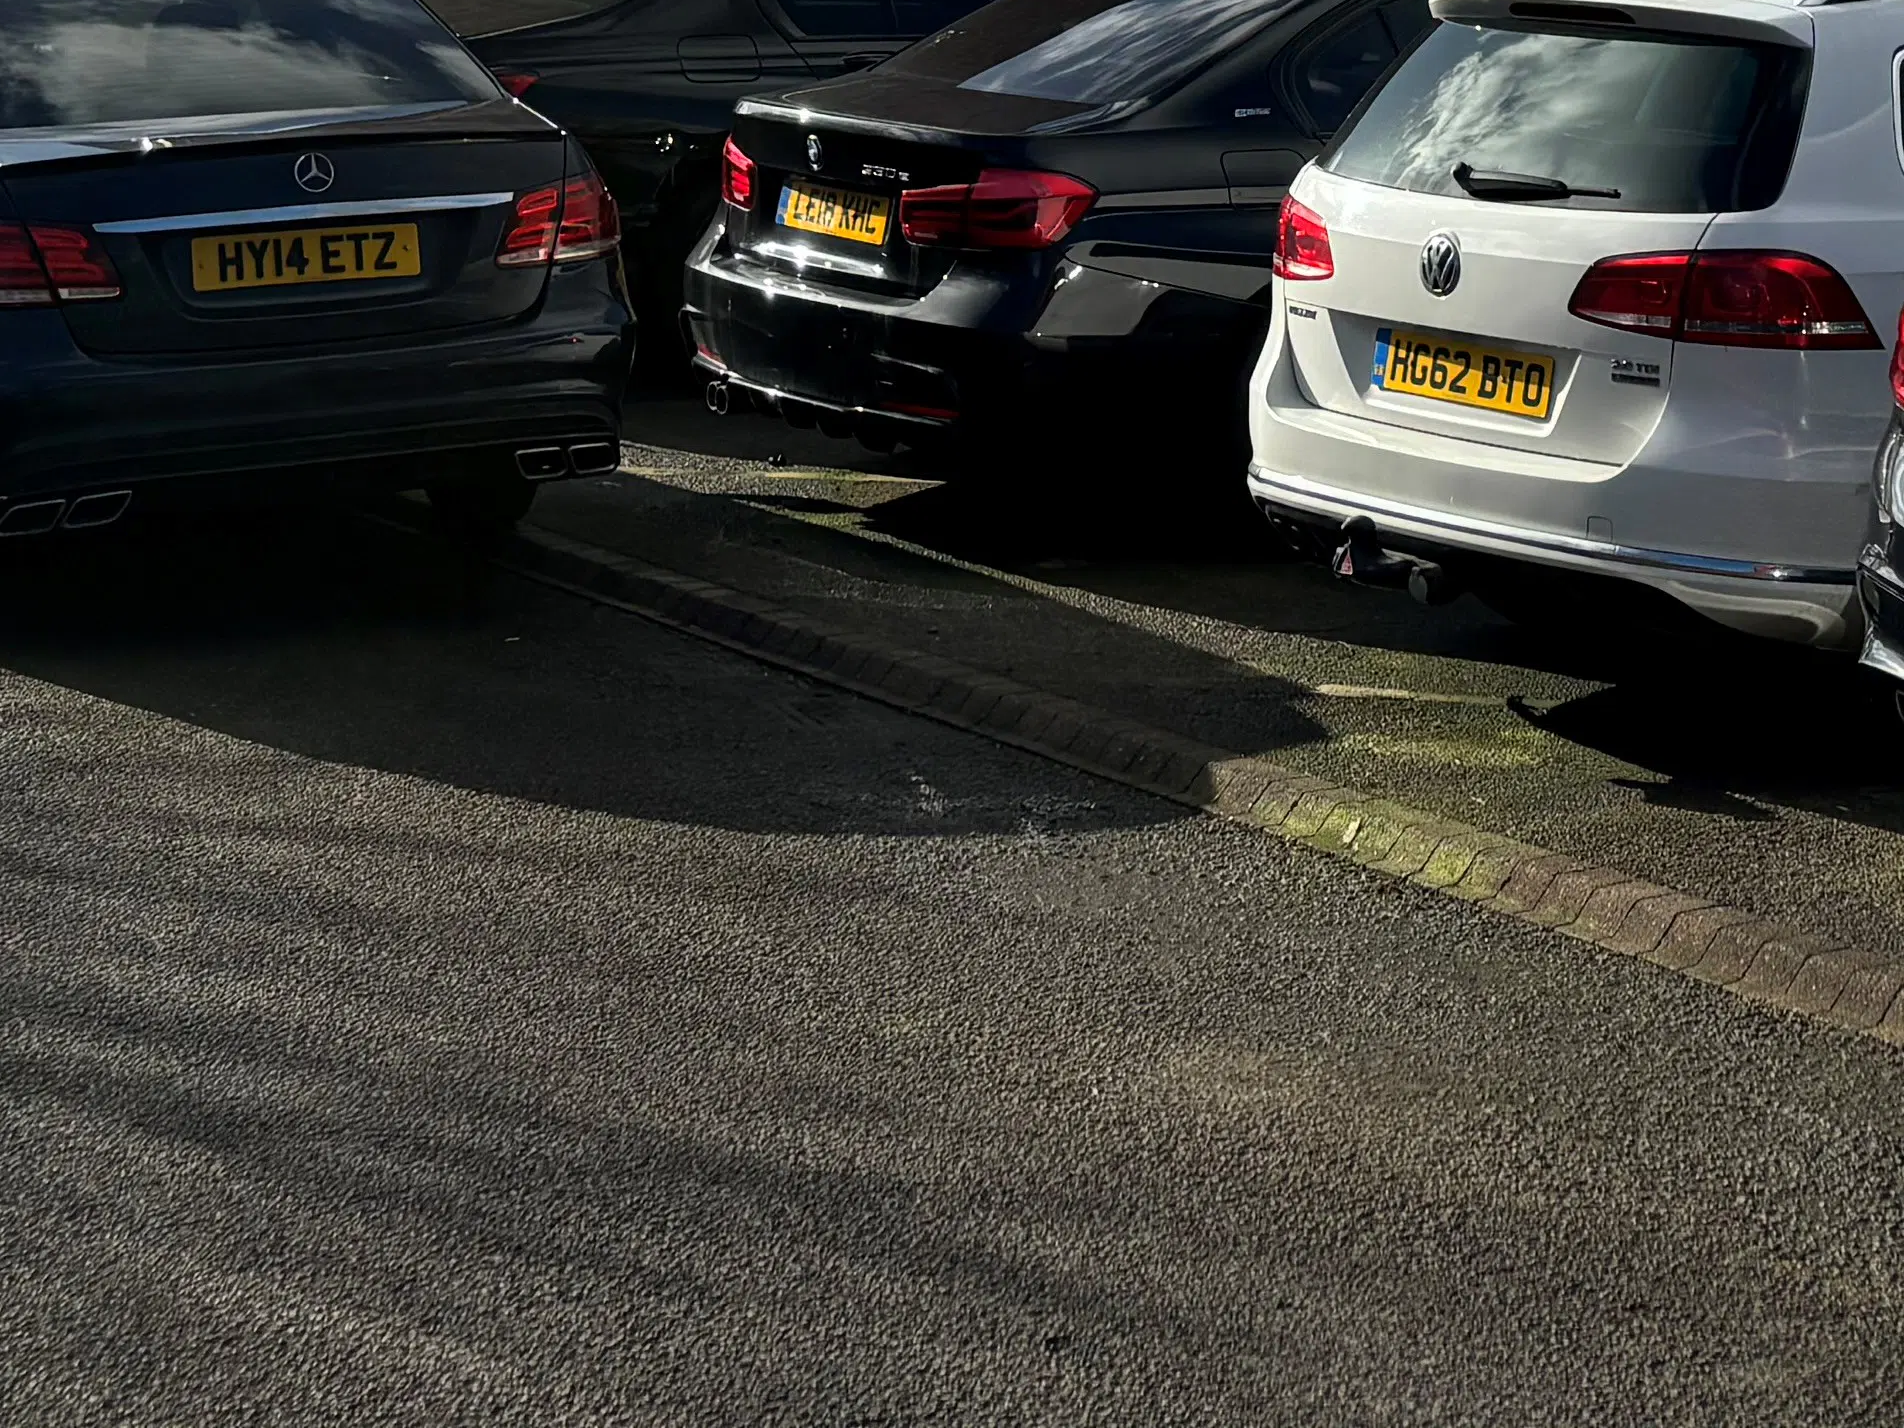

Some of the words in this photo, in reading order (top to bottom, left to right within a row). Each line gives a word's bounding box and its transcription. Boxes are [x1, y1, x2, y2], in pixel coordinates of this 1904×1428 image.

[217, 236, 310, 282] HY14
[319, 231, 398, 274] ETZ
[1390, 338, 1472, 395] HG62
[1477, 354, 1546, 408] BTO
